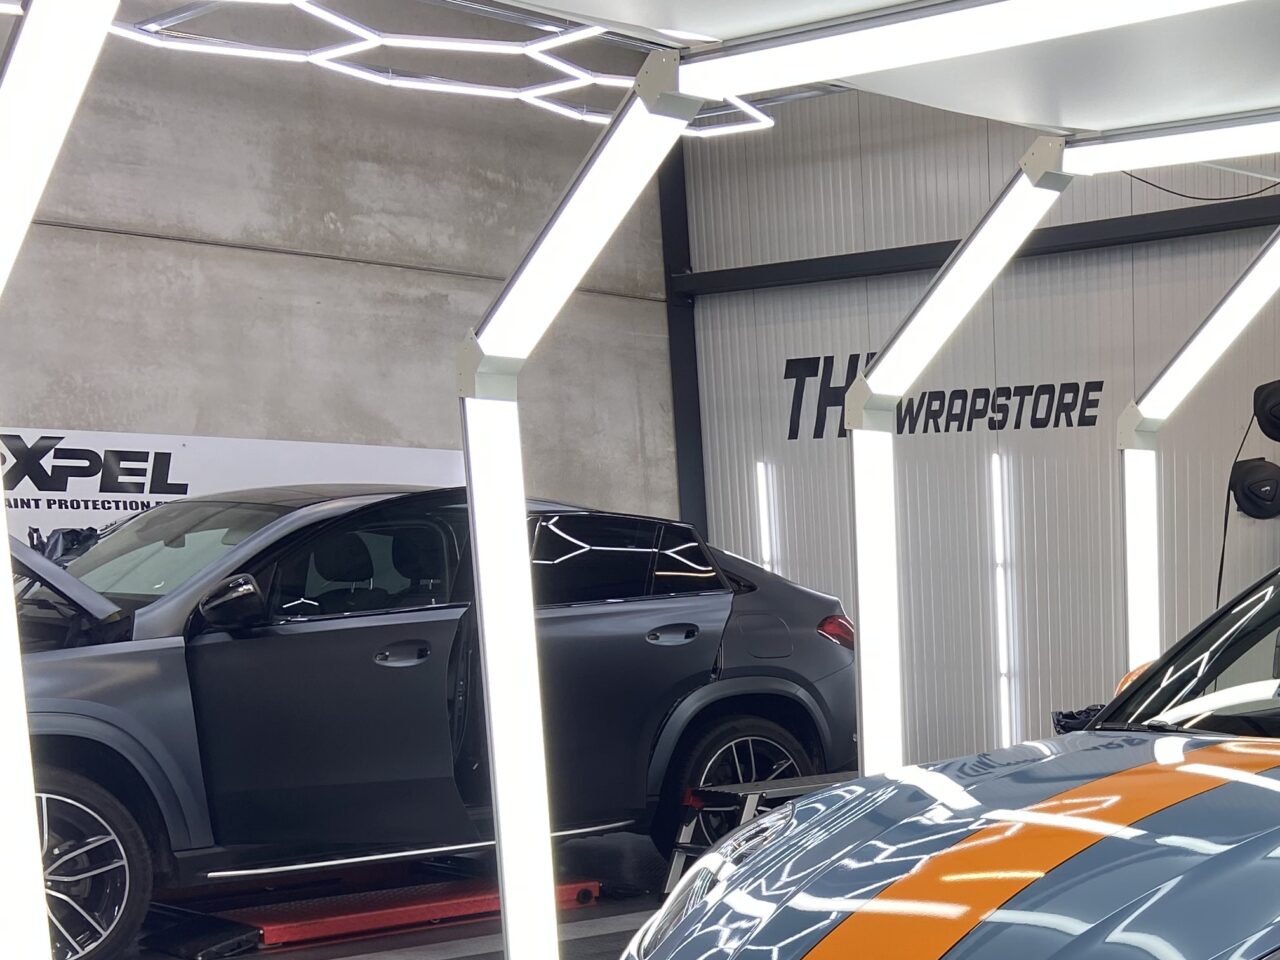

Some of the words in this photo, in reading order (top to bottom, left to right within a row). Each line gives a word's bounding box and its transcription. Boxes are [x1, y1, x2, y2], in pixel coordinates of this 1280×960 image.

[784, 352, 878, 440] TH
[896, 381, 1104, 434] WRAPSTORE
[0, 434, 188, 495] XPEL
[5, 498, 42, 509] AINT
[46, 499, 151, 511] PROTECTION
